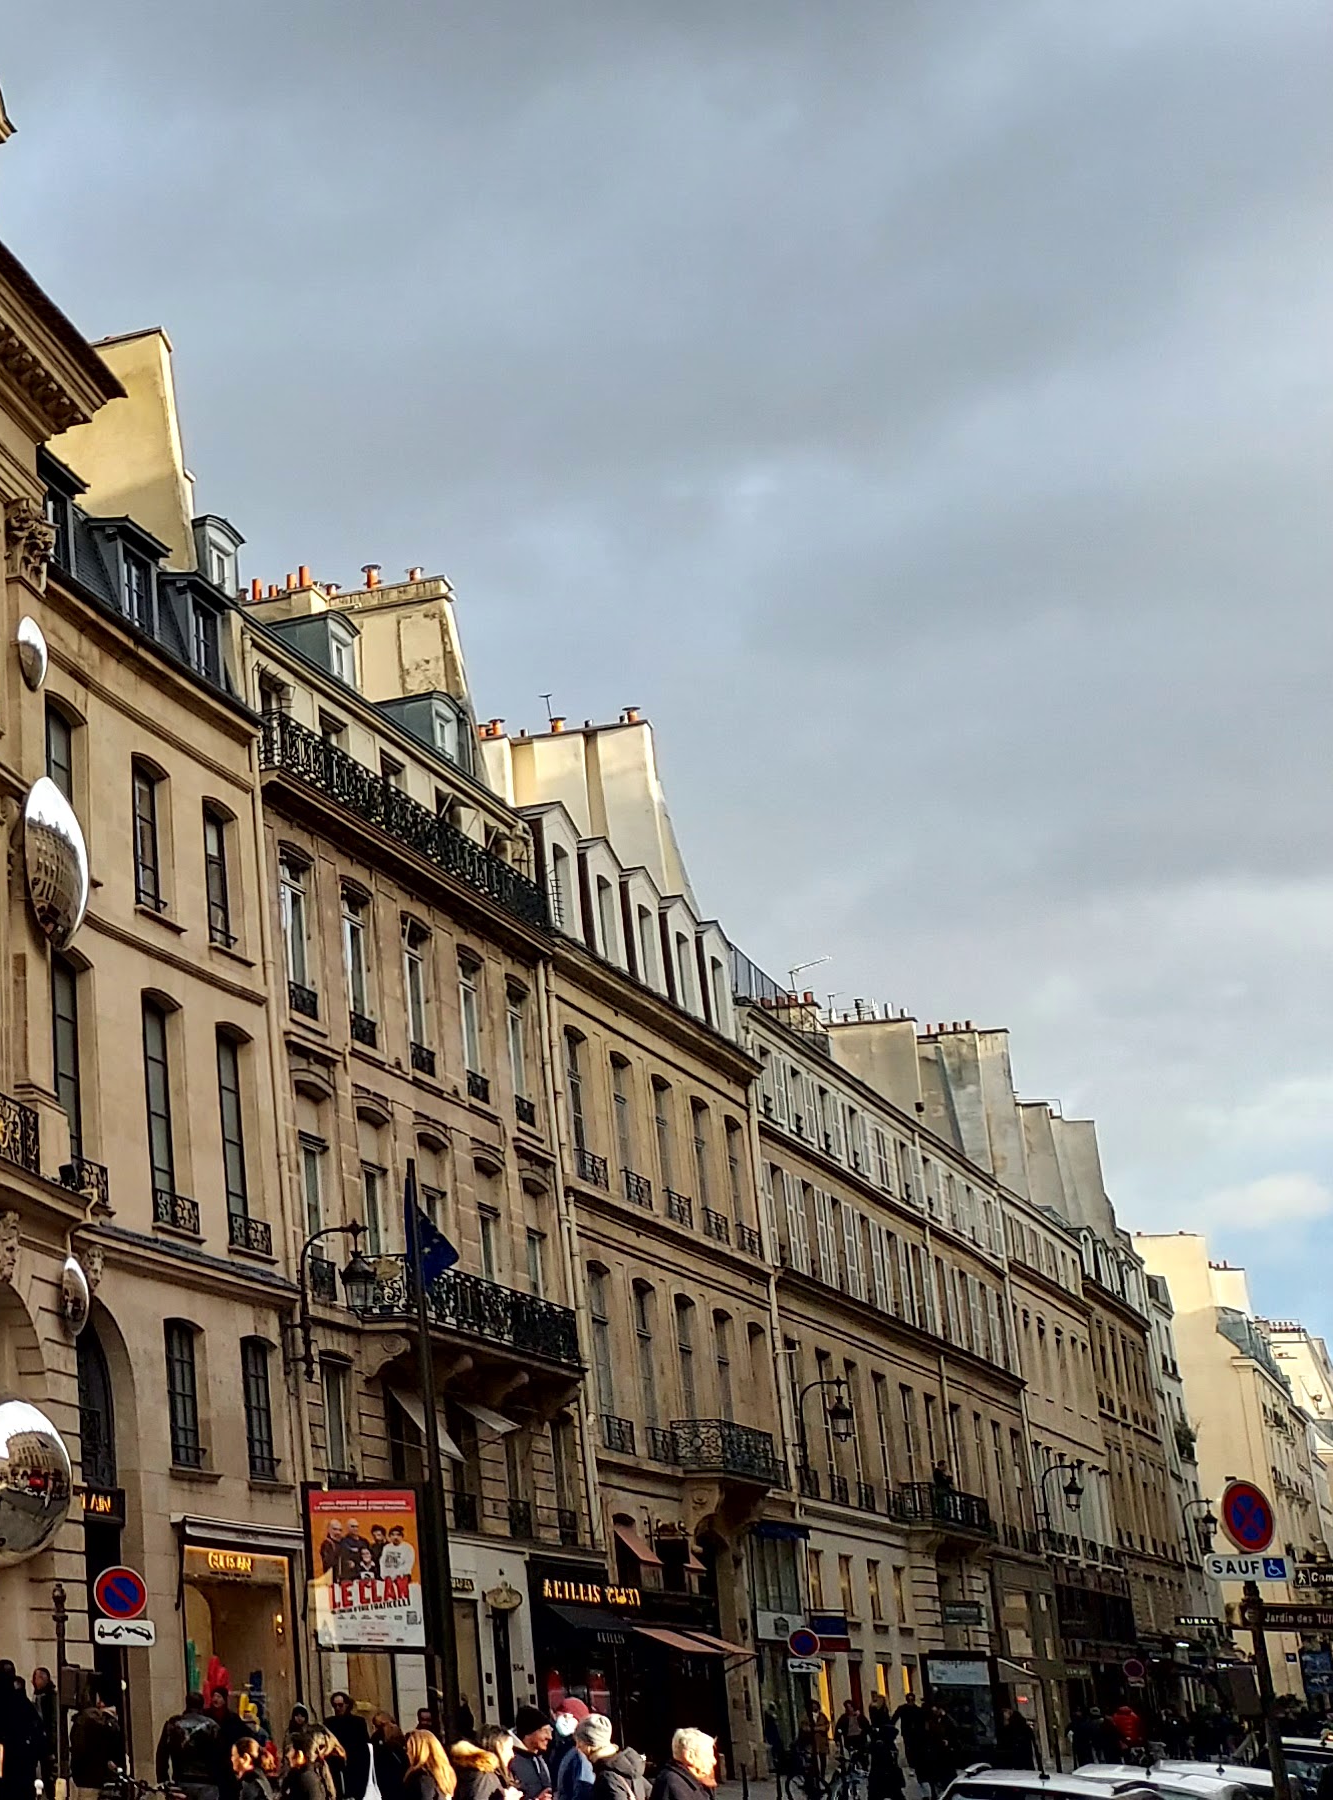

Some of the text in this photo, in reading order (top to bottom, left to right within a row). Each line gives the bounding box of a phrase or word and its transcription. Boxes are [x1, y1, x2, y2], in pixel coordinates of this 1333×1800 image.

[1211, 1560, 1260, 1575] SAUF
[328, 1574, 411, 1611] LE CLAN
[1264, 1611, 1295, 1624] Jardin
[1296, 1613, 1314, 1624] des
